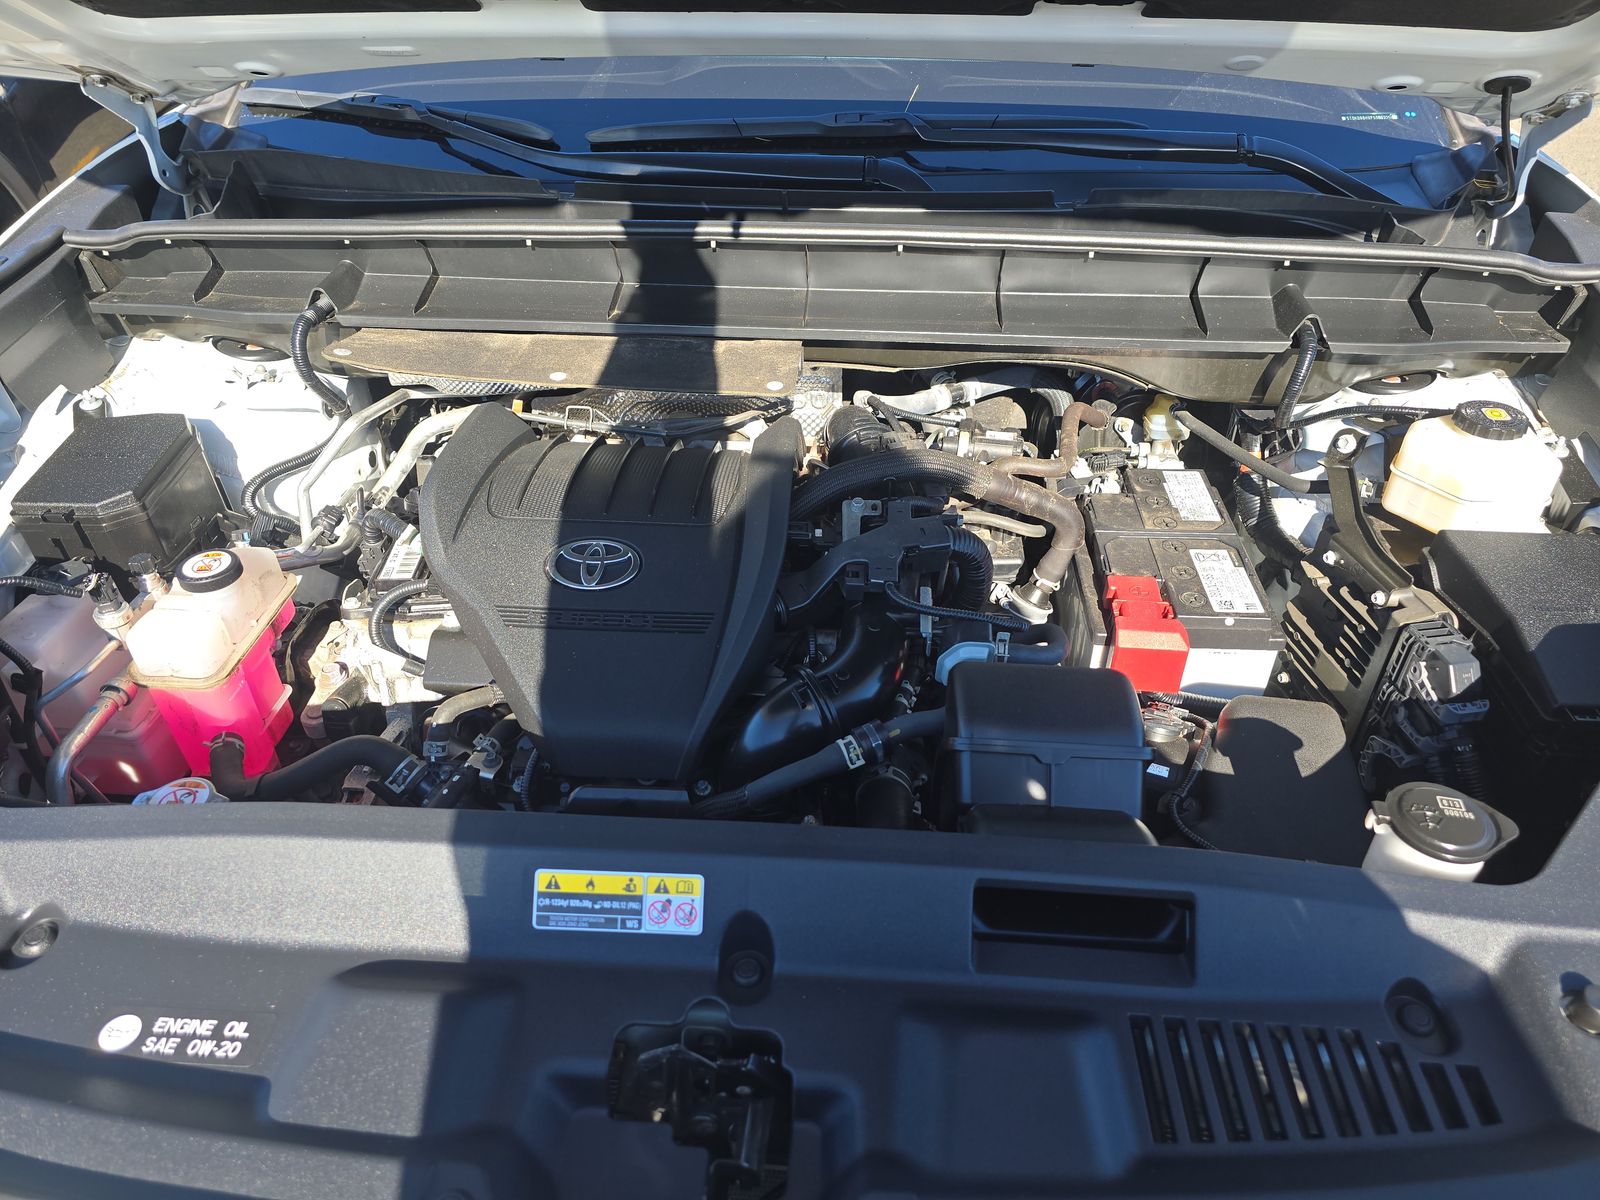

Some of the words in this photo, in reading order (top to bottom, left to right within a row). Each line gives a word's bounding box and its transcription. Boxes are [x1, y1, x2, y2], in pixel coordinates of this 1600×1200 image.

[152, 1017, 218, 1036] ENGINE
[223, 1020, 250, 1039] OIL
[141, 1037, 181, 1055] SAE
[186, 1039, 242, 1059] 0W-20
